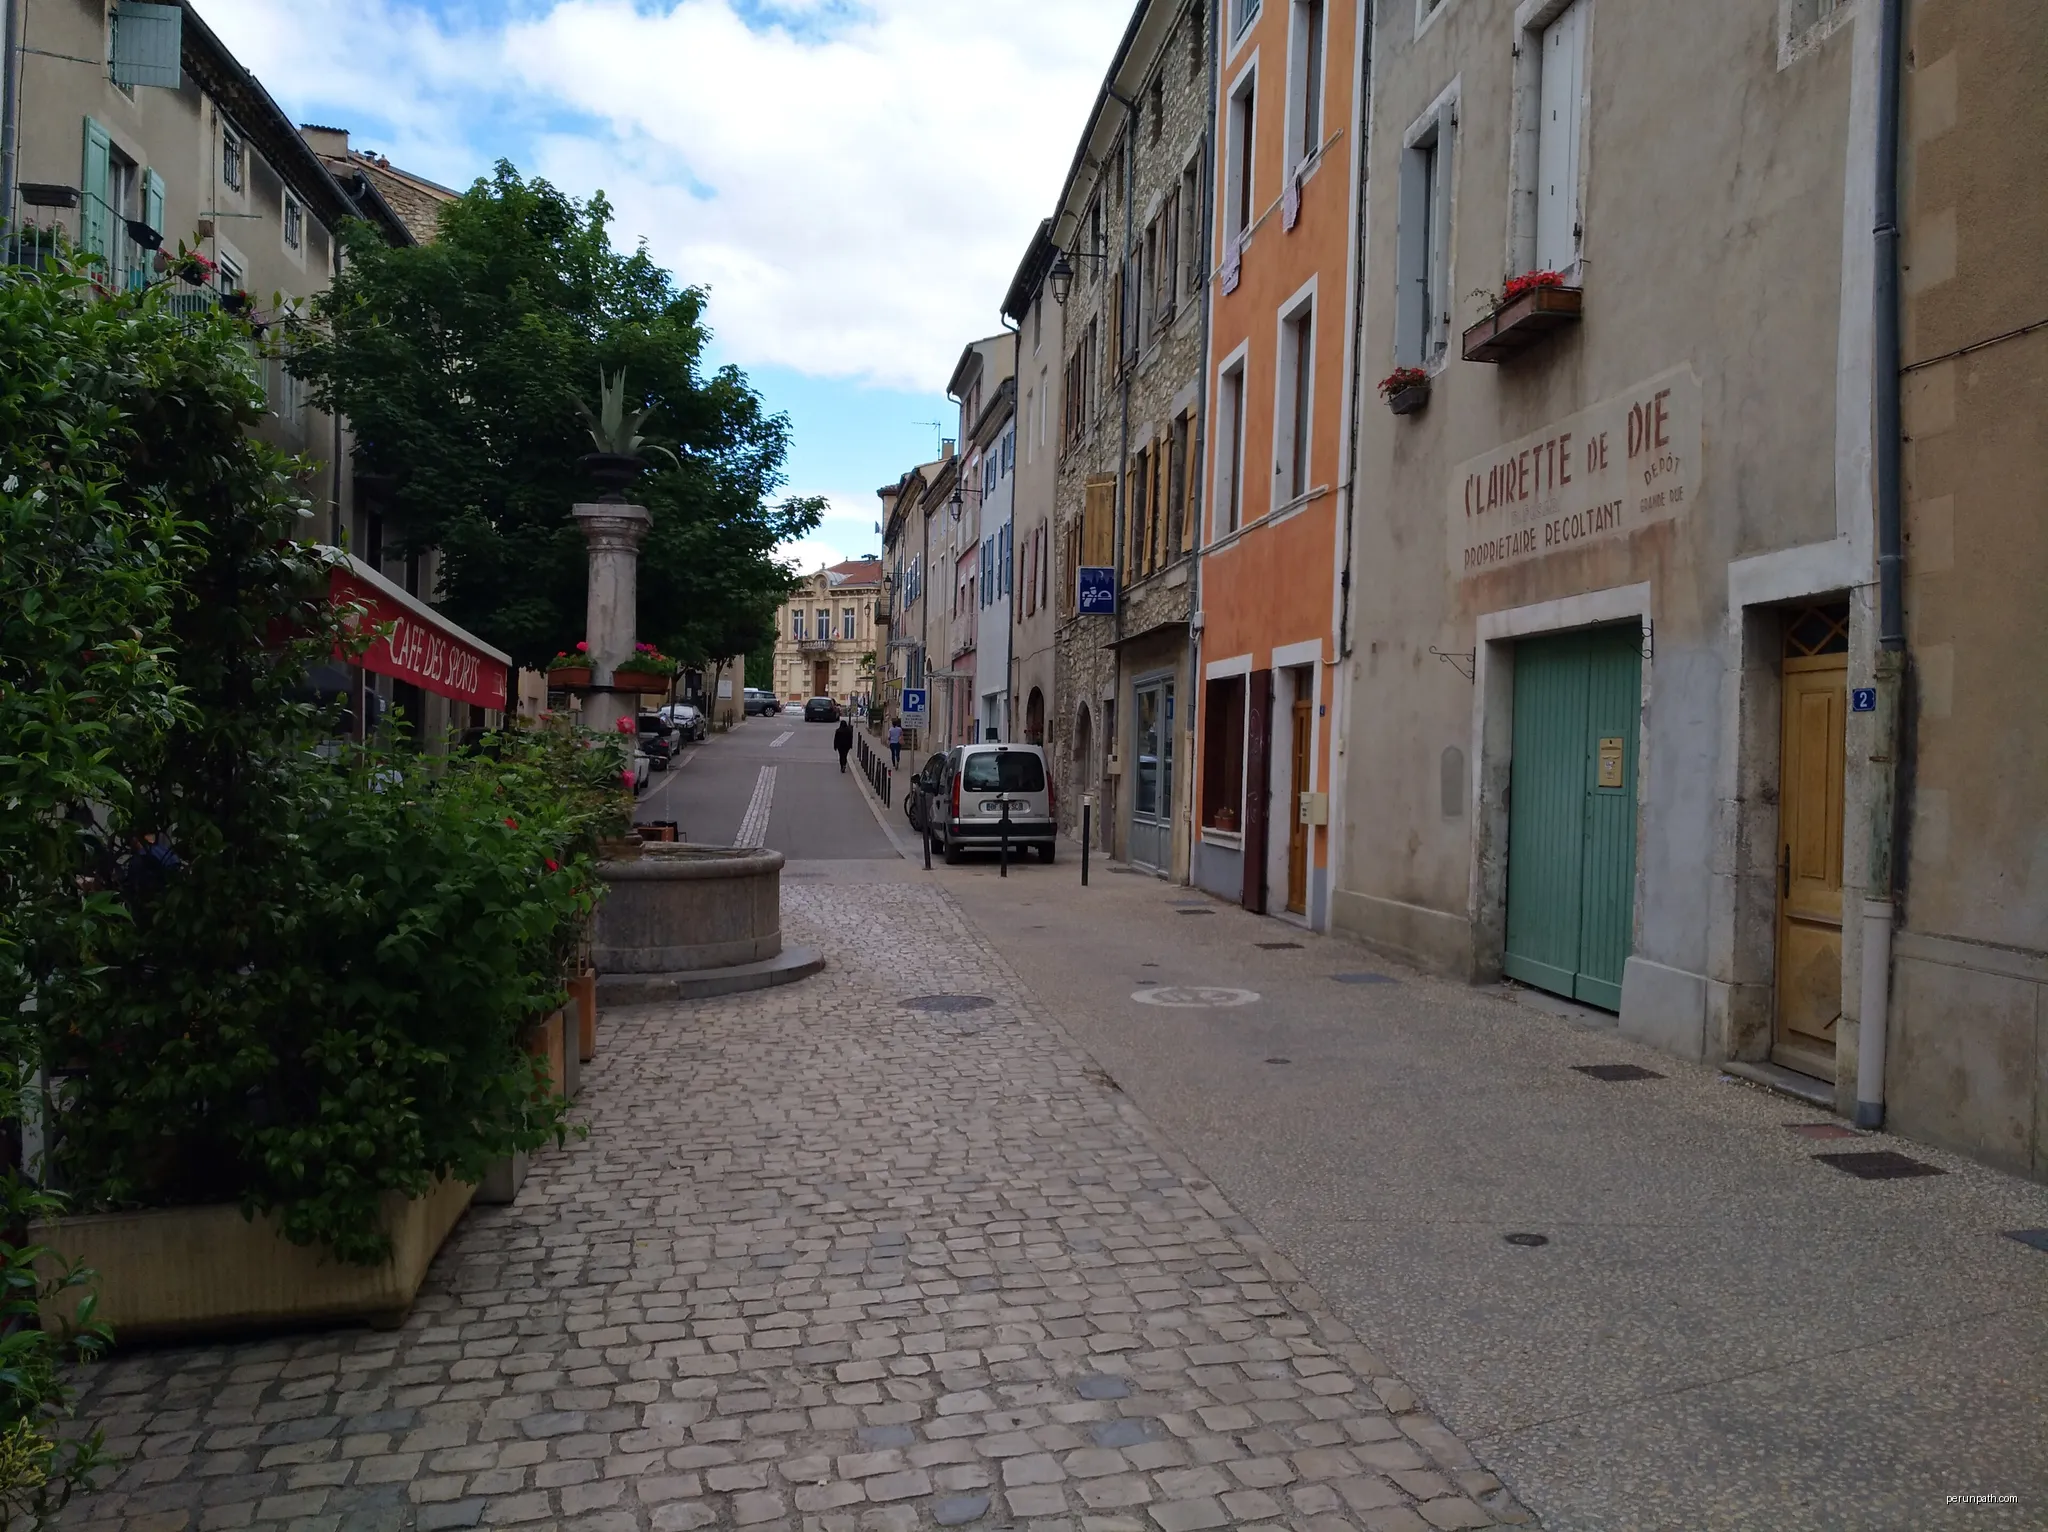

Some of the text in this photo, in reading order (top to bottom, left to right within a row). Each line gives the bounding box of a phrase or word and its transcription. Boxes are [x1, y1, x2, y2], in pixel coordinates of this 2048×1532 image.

[1464, 432, 1572, 518] CLAIRETTE
[1587, 431, 1608, 475] DE
[1627, 388, 1671, 459] DIE
[389, 616, 481, 694] CAFE DES SPORTS
[908, 693, 920, 709] P
[1859, 691, 1868, 708] 2
